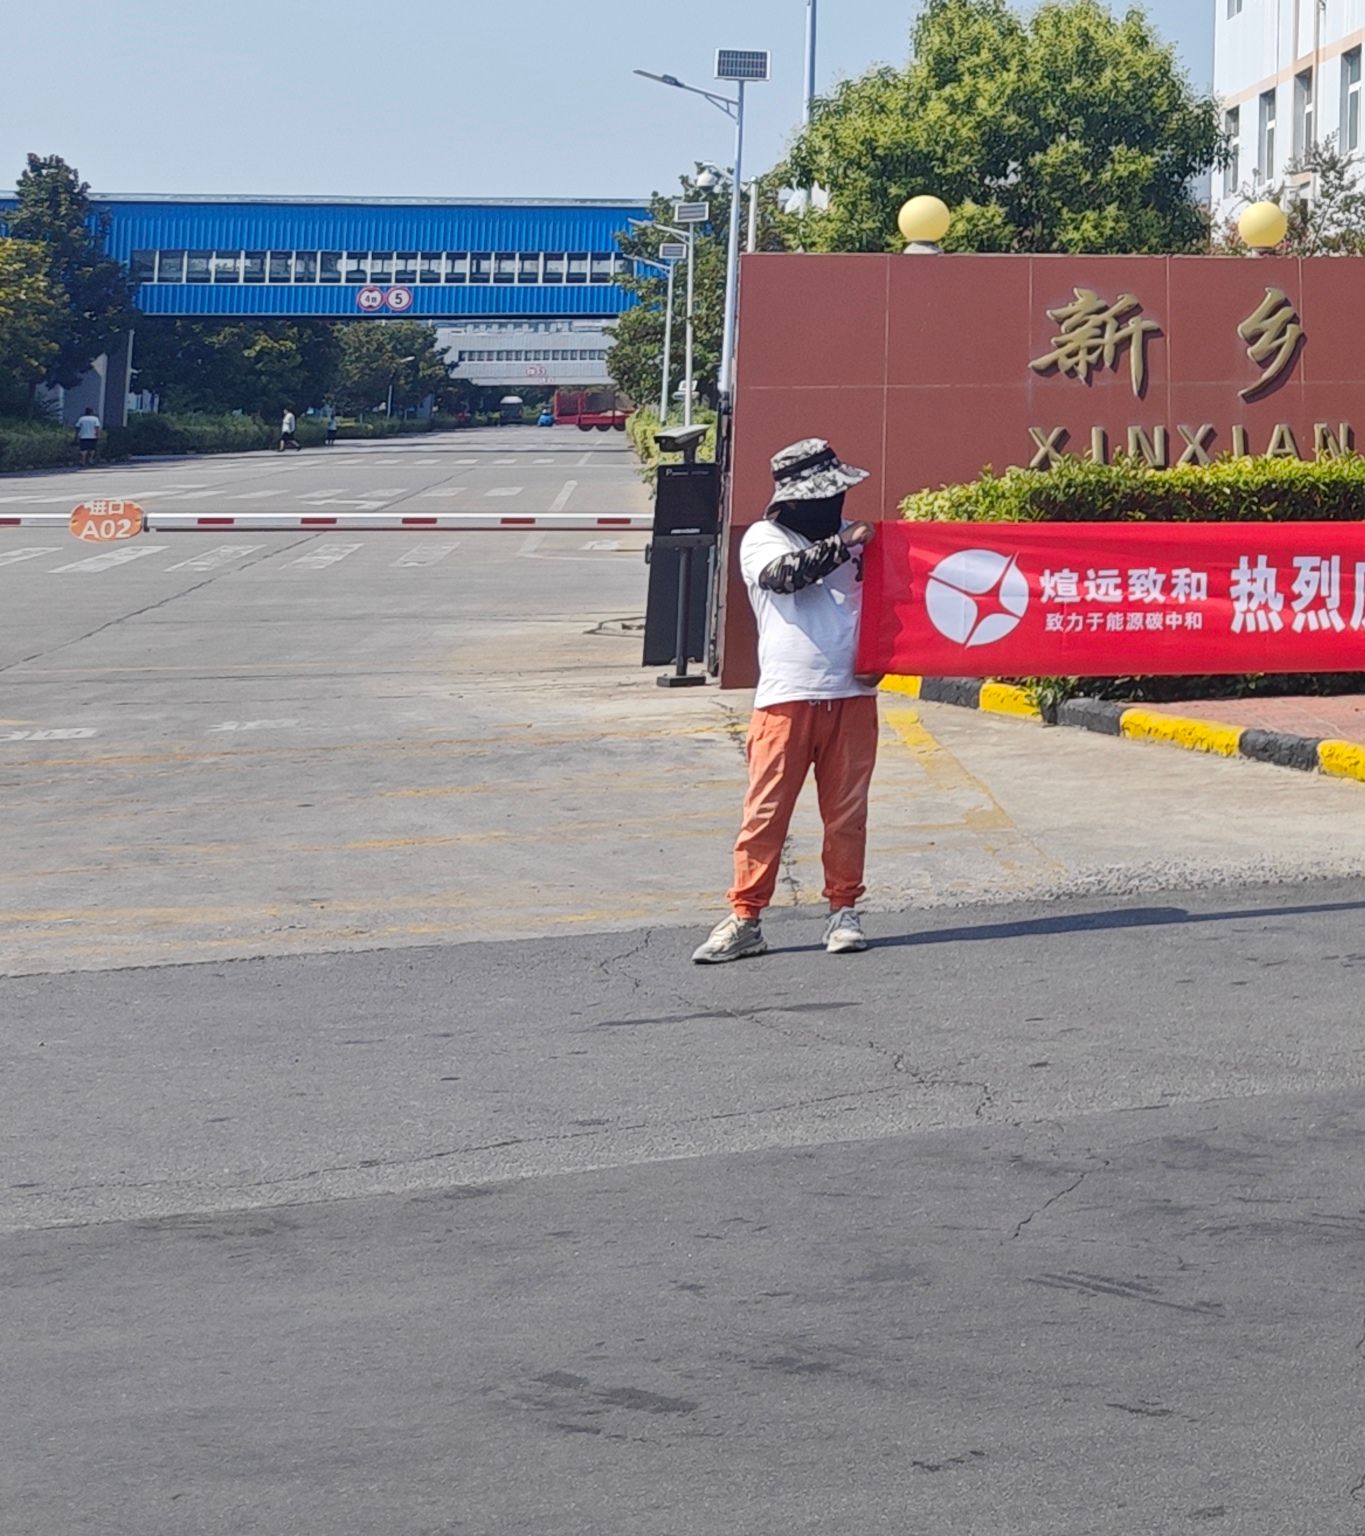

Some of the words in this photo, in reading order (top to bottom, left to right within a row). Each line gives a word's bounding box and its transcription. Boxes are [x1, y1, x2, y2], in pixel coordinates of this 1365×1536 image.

[394, 293, 403, 305] 5
[80, 519, 131, 539] A02
[1039, 567, 1208, 604] 煊远致和
[1045, 611, 1203, 632] 致力于能源碳中和
